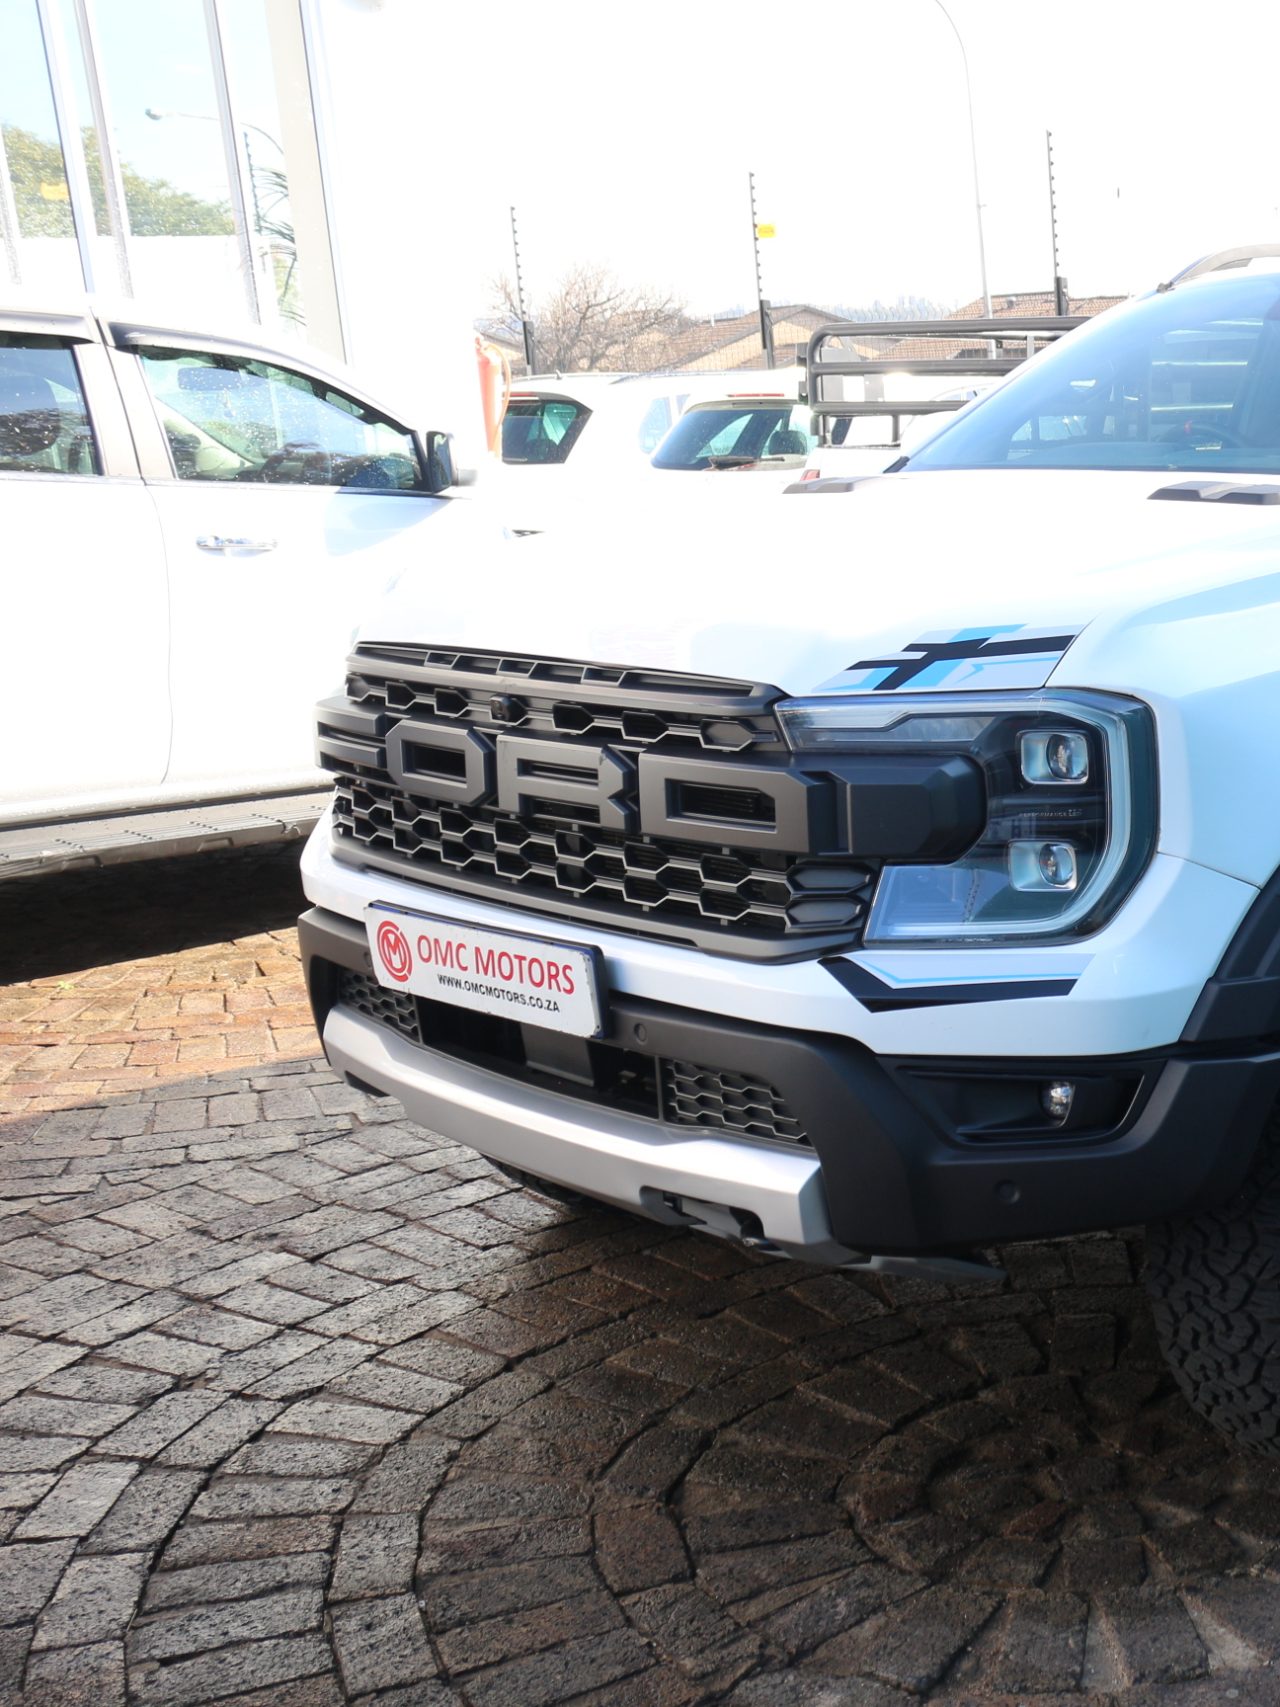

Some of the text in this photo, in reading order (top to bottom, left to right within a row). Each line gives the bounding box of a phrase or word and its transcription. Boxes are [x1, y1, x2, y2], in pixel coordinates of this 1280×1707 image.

[312, 694, 828, 855] FORD
[417, 934, 575, 995] OMC MOTORS
[437, 973, 560, 1013] WWW.OMCMOTORS.CO.ZA
